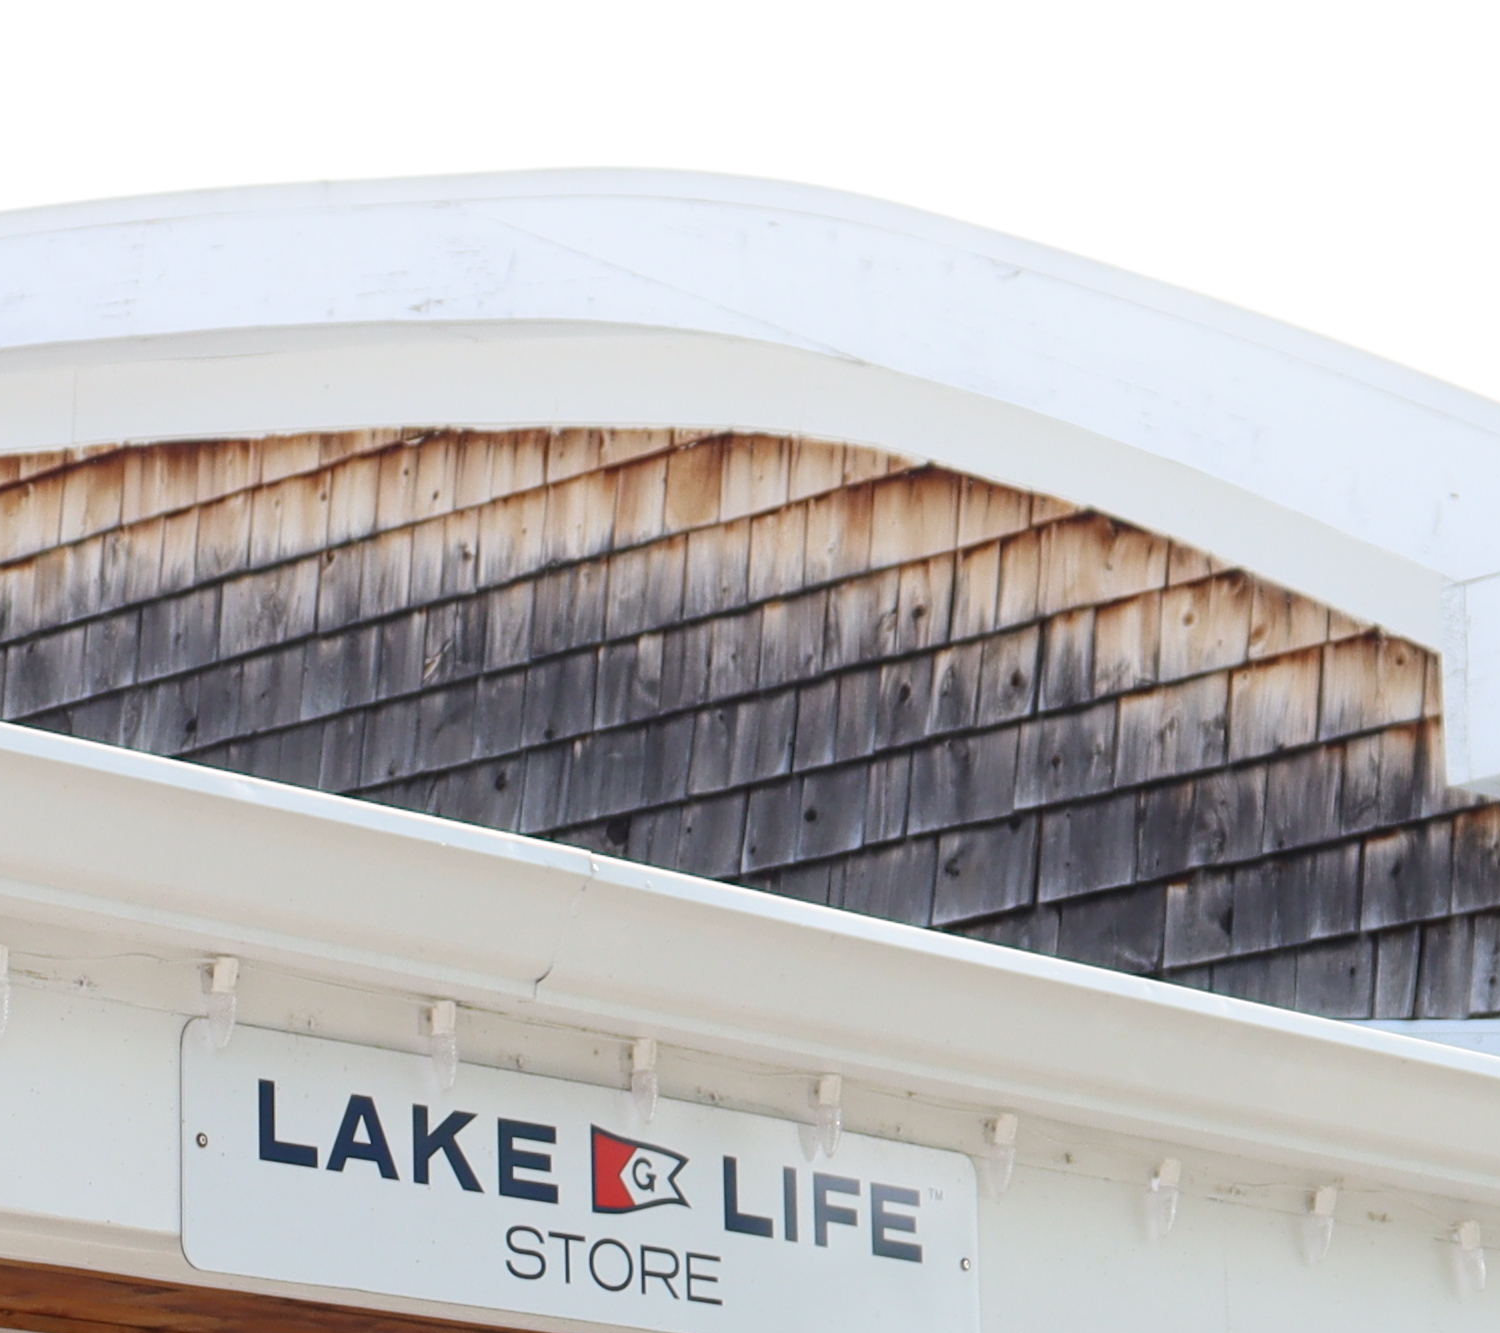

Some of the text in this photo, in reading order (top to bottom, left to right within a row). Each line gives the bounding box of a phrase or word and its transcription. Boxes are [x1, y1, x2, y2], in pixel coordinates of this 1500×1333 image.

[257, 1079, 560, 1205] LAKE
[723, 1155, 922, 1264] LIFE
[505, 1225, 723, 1306] STORE
